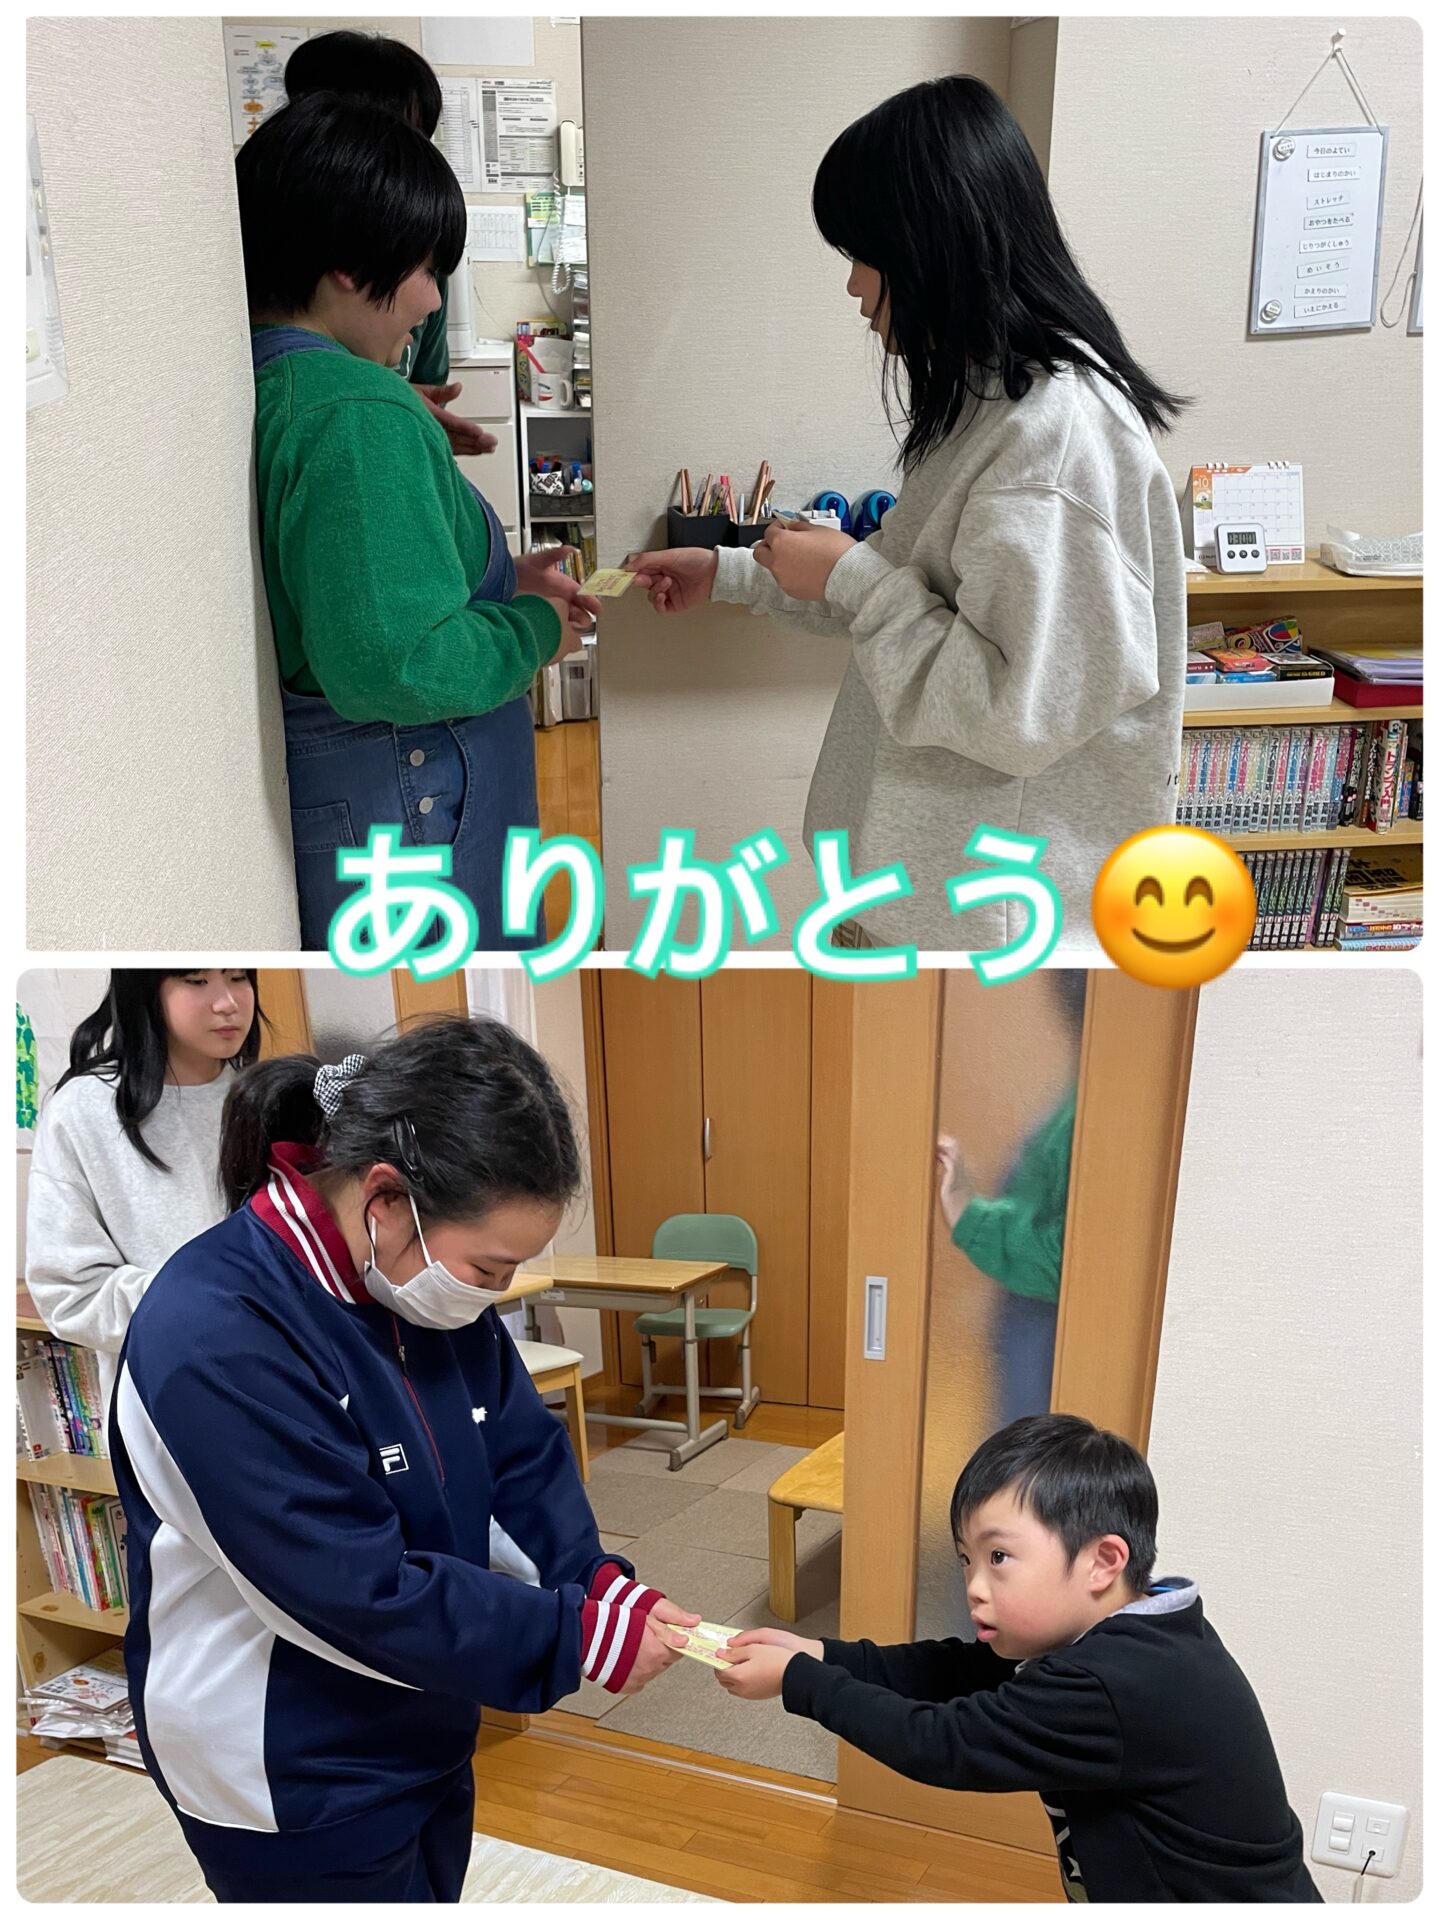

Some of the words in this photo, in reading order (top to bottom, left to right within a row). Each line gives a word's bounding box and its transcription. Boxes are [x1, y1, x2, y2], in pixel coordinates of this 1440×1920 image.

[1313, 147, 1350, 155] 今日のよてい
[1313, 170, 1356, 179] はじまりのかい
[1315, 195, 1343, 206] ストレッチ
[1308, 216, 1350, 227] おやつをたべる
[1304, 287, 1340, 295] かえりのかい
[1303, 302, 1339, 314] いえにかえる
